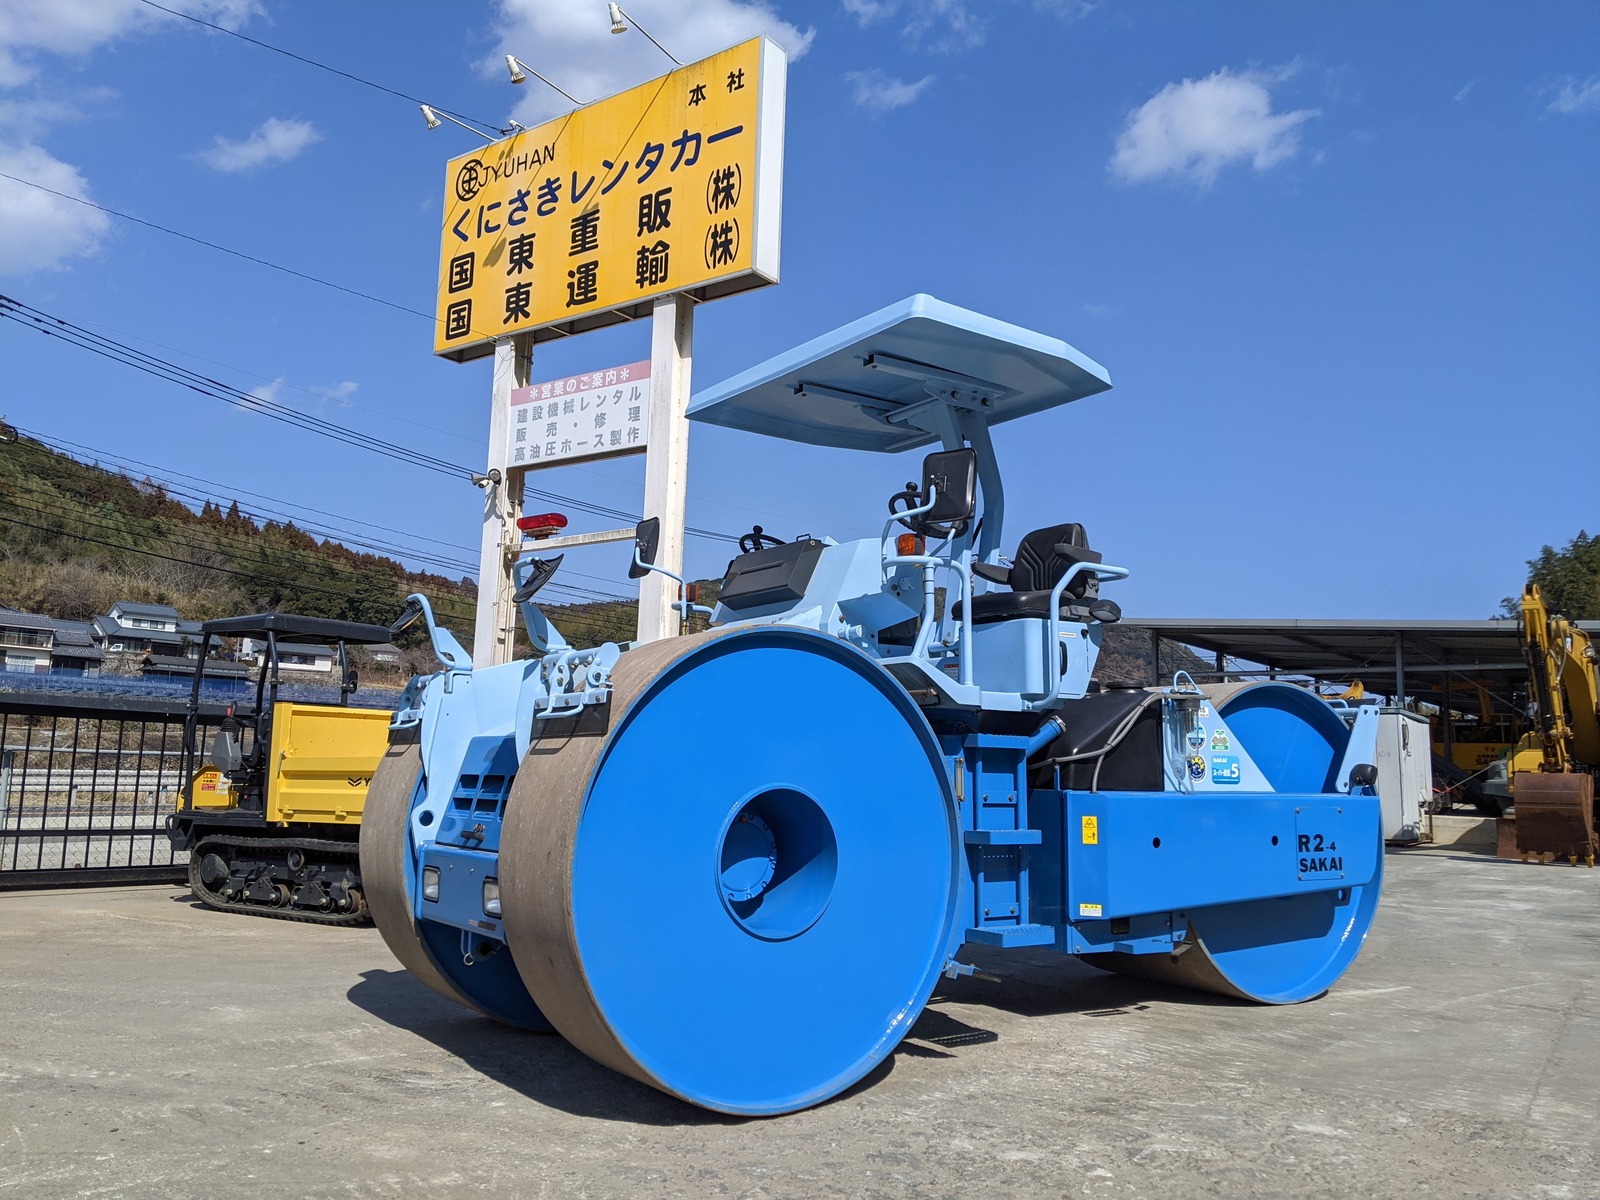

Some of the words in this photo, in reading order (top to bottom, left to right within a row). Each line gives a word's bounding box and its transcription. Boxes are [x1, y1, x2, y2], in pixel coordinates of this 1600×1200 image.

[452, 124, 744, 242] くにさきレンタカー
[517, 386, 642, 424] 建設機械レンタル
[514, 427, 640, 462] 高油圧ホース製作
[1299, 857, 1343, 873] SAKAI
